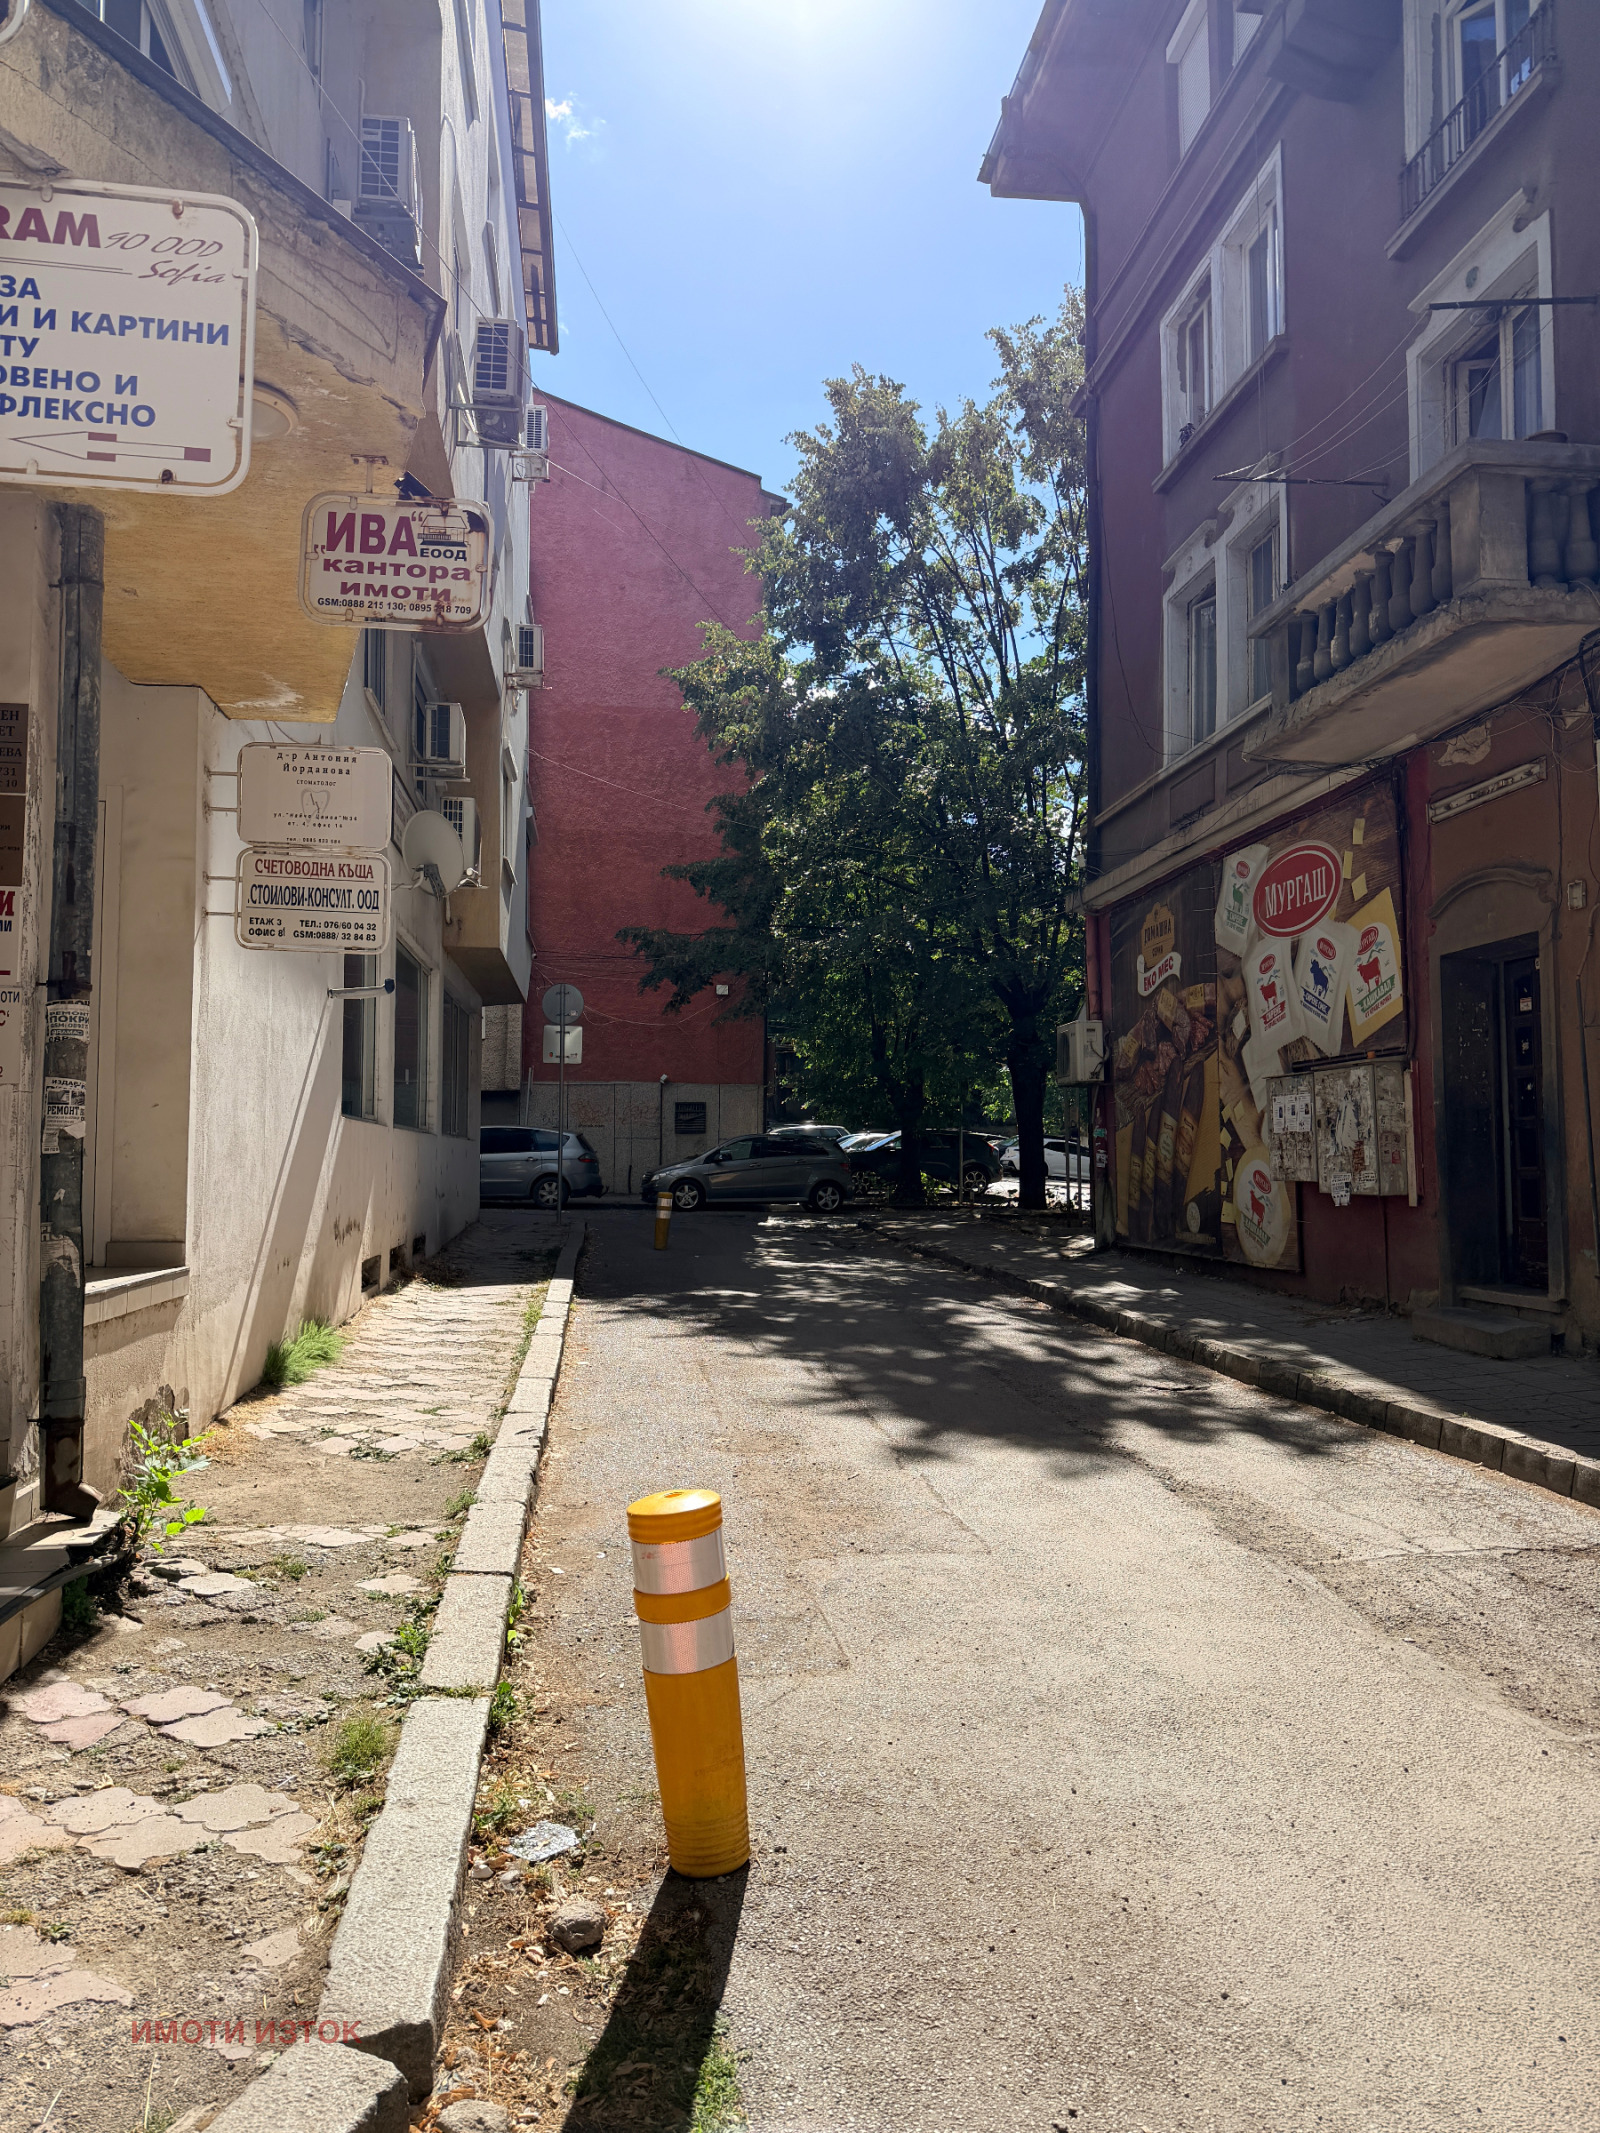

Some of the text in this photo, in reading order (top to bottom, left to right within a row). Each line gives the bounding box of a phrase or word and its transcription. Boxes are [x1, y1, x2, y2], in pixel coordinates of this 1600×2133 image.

[138, 260, 226, 286] Sofia
[0, 275, 41, 300] ЗА
[33, 307, 56, 330] И
[70, 310, 230, 346] КАРТИНИ
[114, 374, 138, 397] И
[419, 547, 468, 561] ЕООД
[322, 558, 471, 583] кантора
[339, 581, 452, 602] имоти
[317, 597, 365, 608] GSM:0888
[367, 600, 384, 610] 215
[387, 602, 407, 612] 130;
[408, 603, 432, 612] 0895
[454, 605, 472, 615] 709
[304, 752, 357, 763] Антония
[283, 762, 350, 774] Йорданова
[254, 858, 374, 880] СЧЕТОВОДНА КЪЩА
[356, 889, 380, 911] ООД
[1264, 866, 1327, 919] МУРГАШ
[249, 917, 282, 926] ЕТАЖ 3
[354, 922, 364, 930] 04
[366, 923, 377, 931] 32
[248, 928, 276, 937] ОФИС
[341, 931, 352, 940] 32
[353, 931, 364, 941] 84
[365, 932, 377, 941] 83
[47, 1105, 79, 1115] РЕМОНТ
